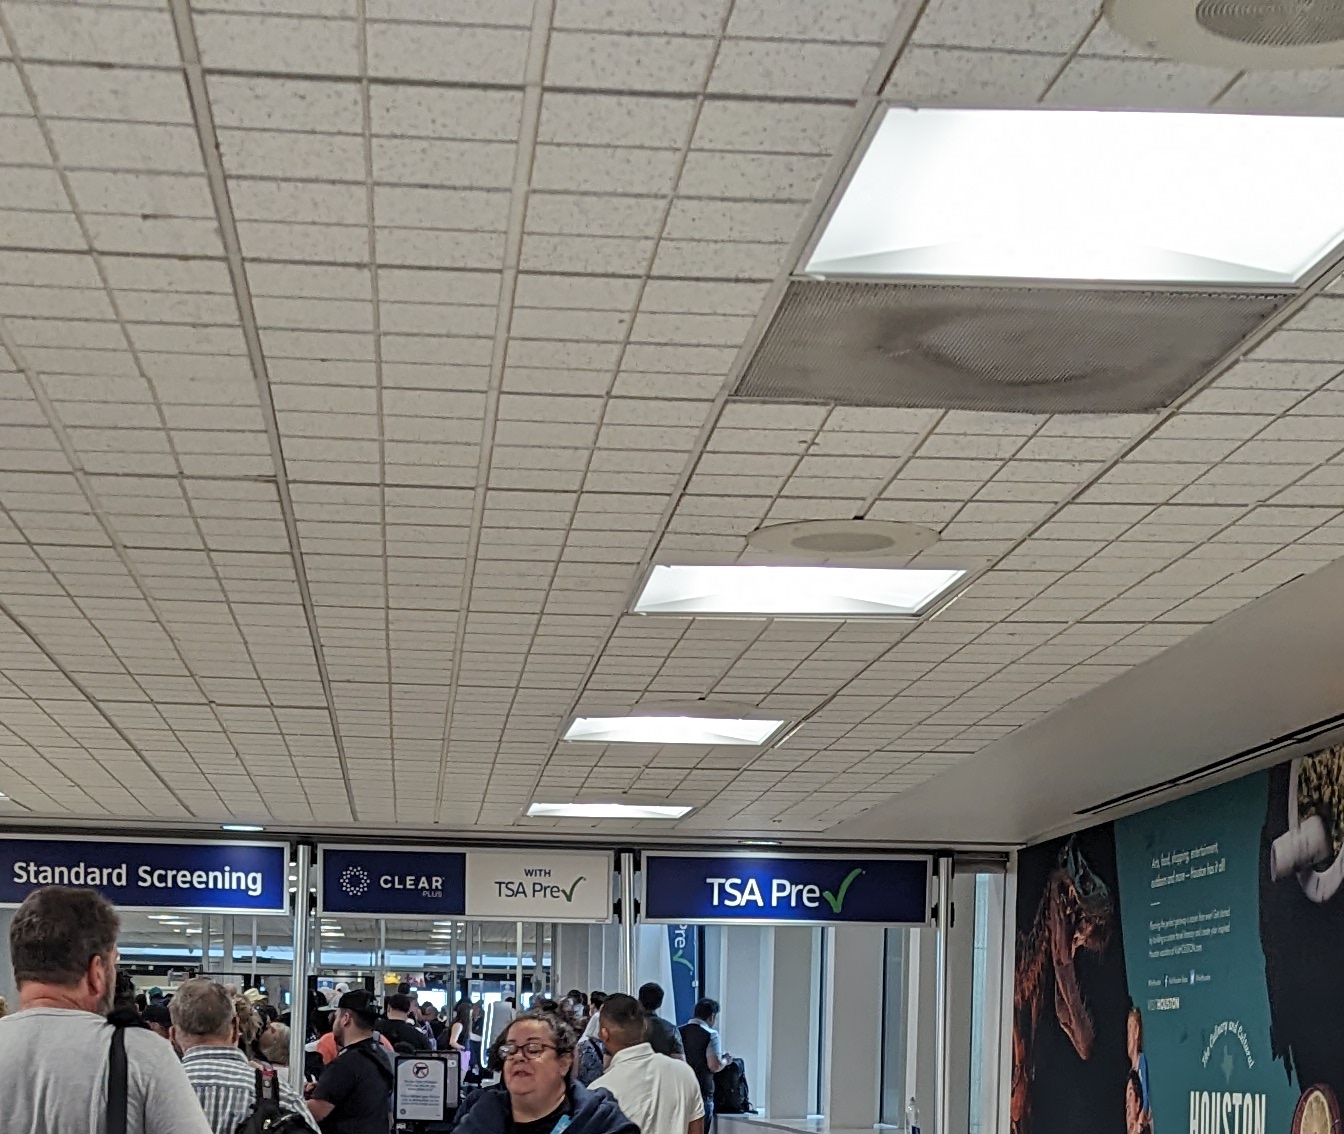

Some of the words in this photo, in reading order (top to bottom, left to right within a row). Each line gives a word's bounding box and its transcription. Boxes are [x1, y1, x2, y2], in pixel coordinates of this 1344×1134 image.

[13, 861, 127, 887] Standard
[137, 865, 263, 896] Screening
[524, 868, 551, 878] WITH
[379, 875, 443, 890] CLEAR
[494, 881, 528, 898] TSA
[532, 882, 561, 899] Pre
[422, 890, 443, 898] PLUS
[706, 877, 764, 907] TSA
[771, 879, 821, 908] Pre
